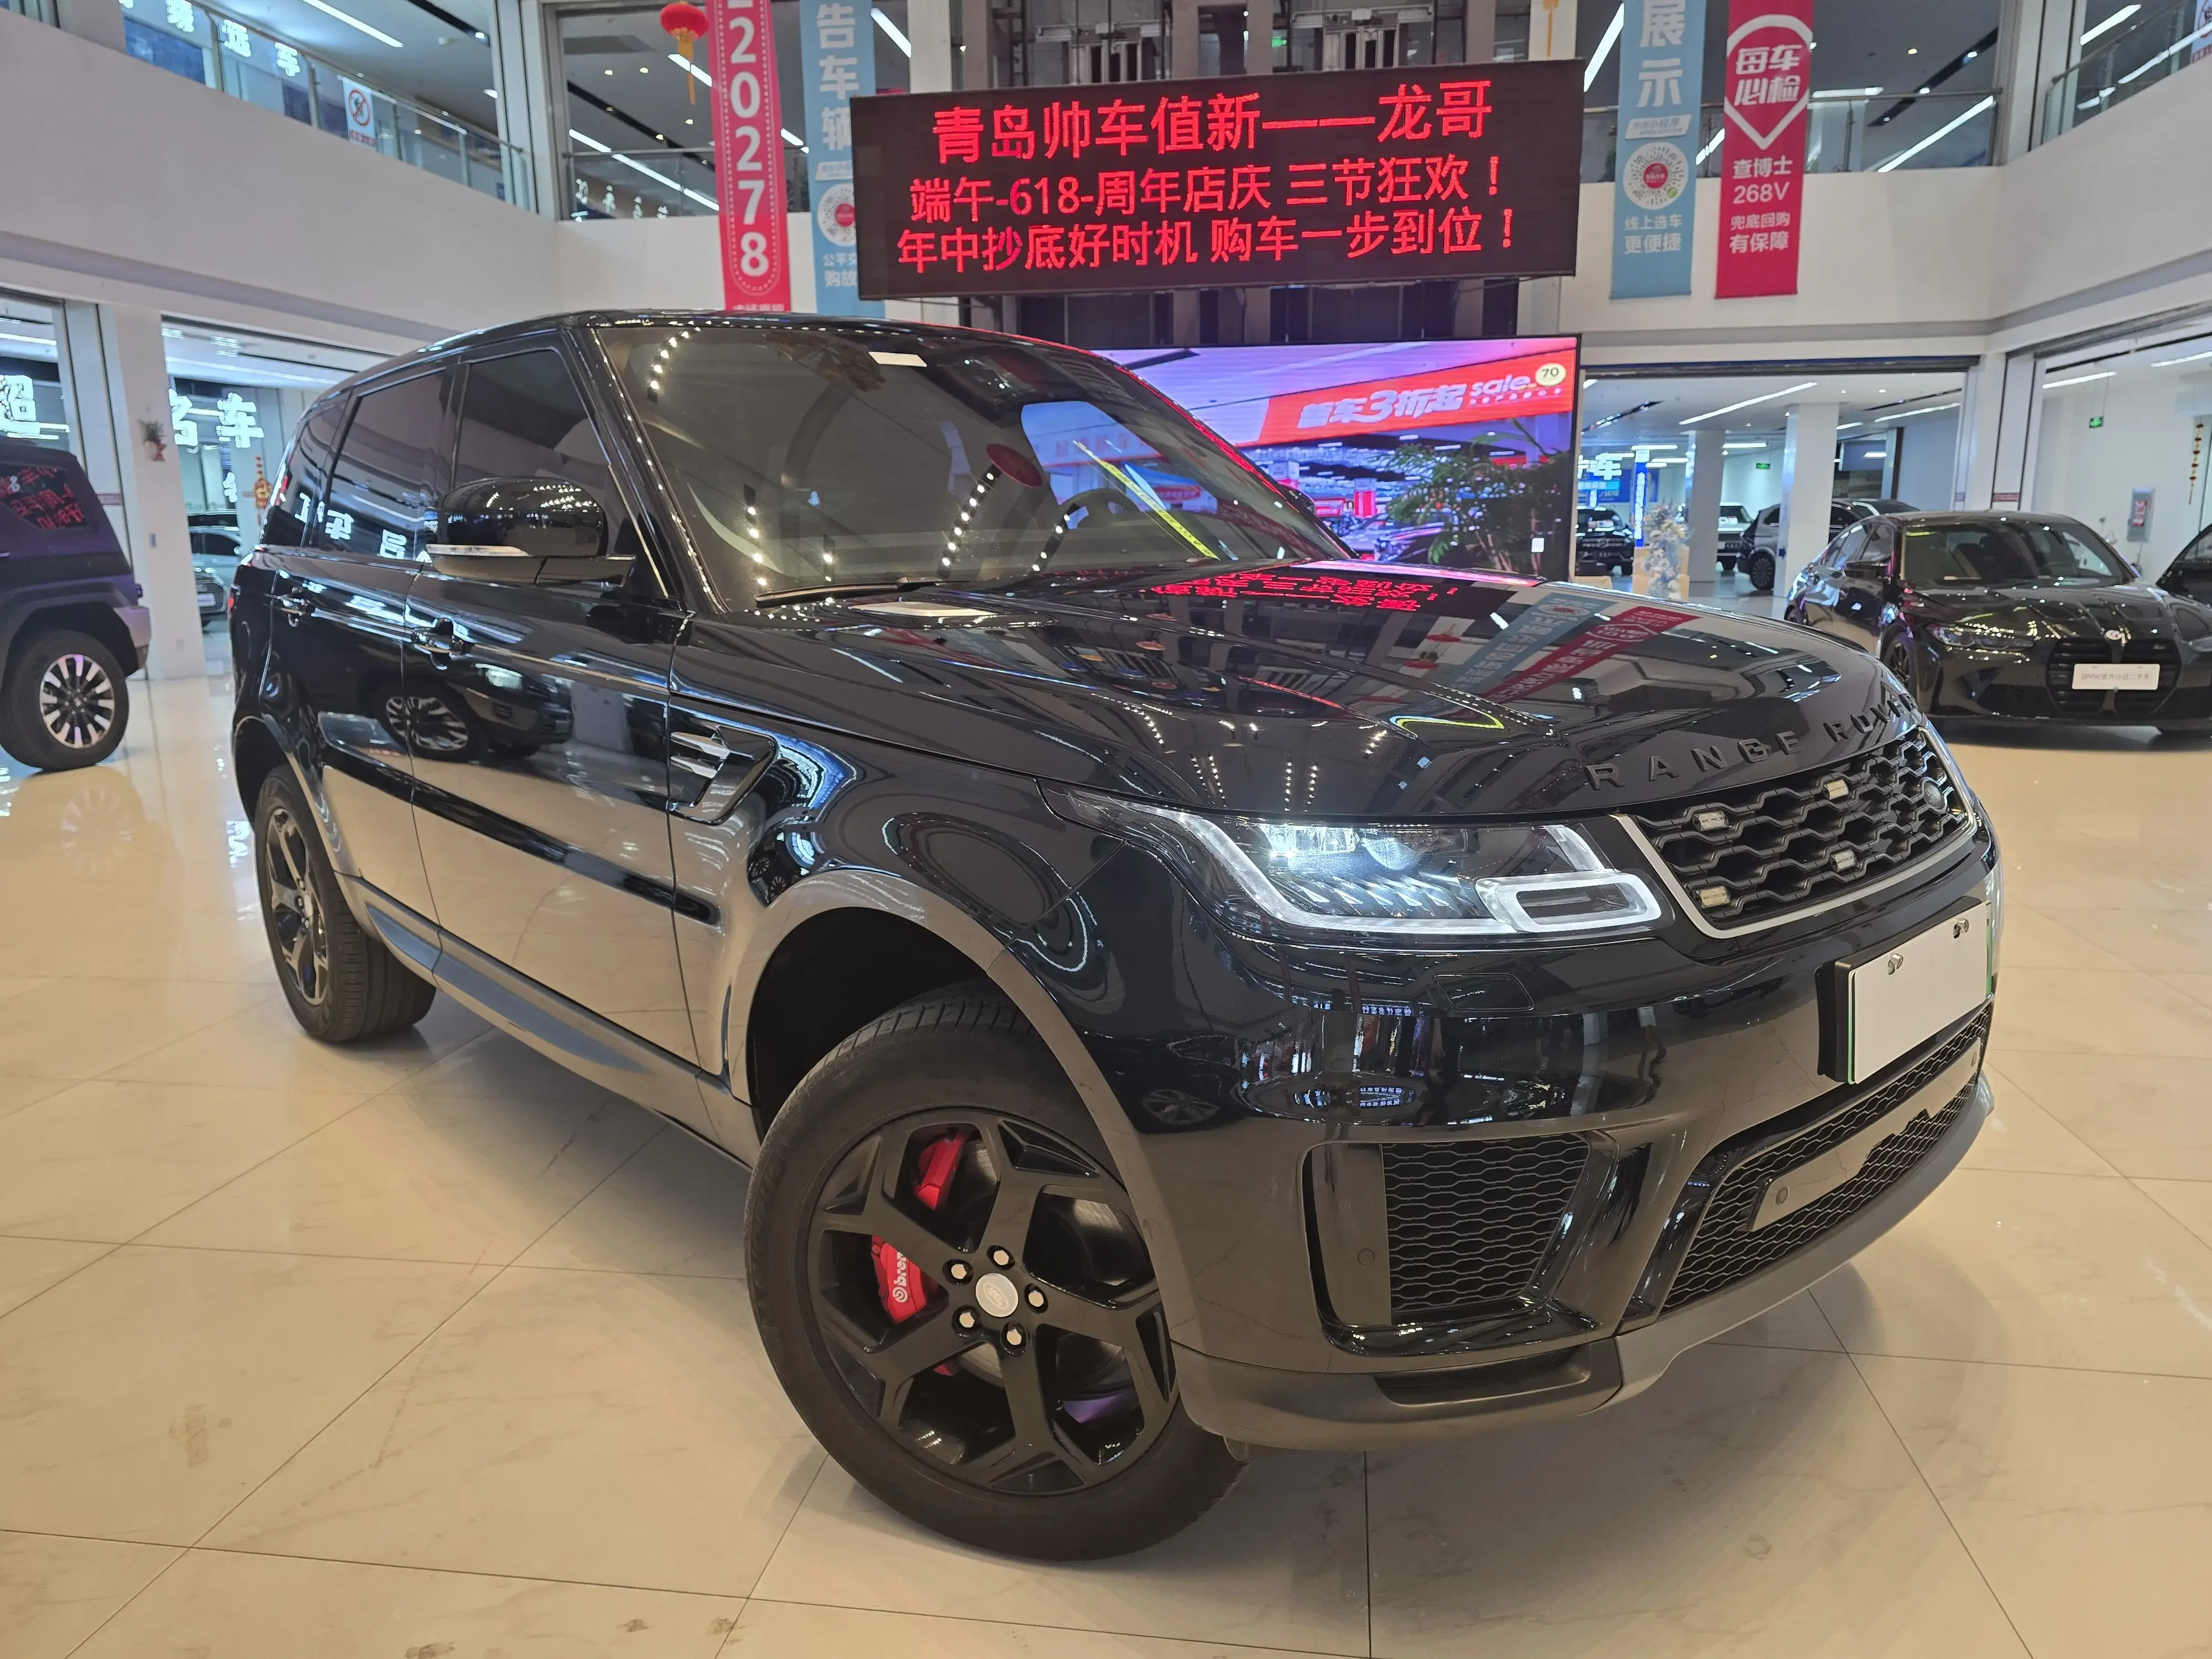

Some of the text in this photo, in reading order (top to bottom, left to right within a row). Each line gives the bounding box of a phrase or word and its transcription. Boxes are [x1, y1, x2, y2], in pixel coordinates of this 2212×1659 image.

[1636, 0, 1686, 108] 展示
[1735, 44, 1802, 76] 每车
[1734, 75, 1801, 106] 必检
[726, 0, 770, 277] 20278
[1733, 155, 1793, 180] 查博士
[1733, 182, 1791, 205] 268V
[1624, 213, 1683, 231] 线上选车
[1624, 232, 1682, 254] 更便捷
[1729, 231, 1790, 254] 有保障
[1542, 367, 1559, 378] 70
[1585, 731, 1805, 790] RANGE
